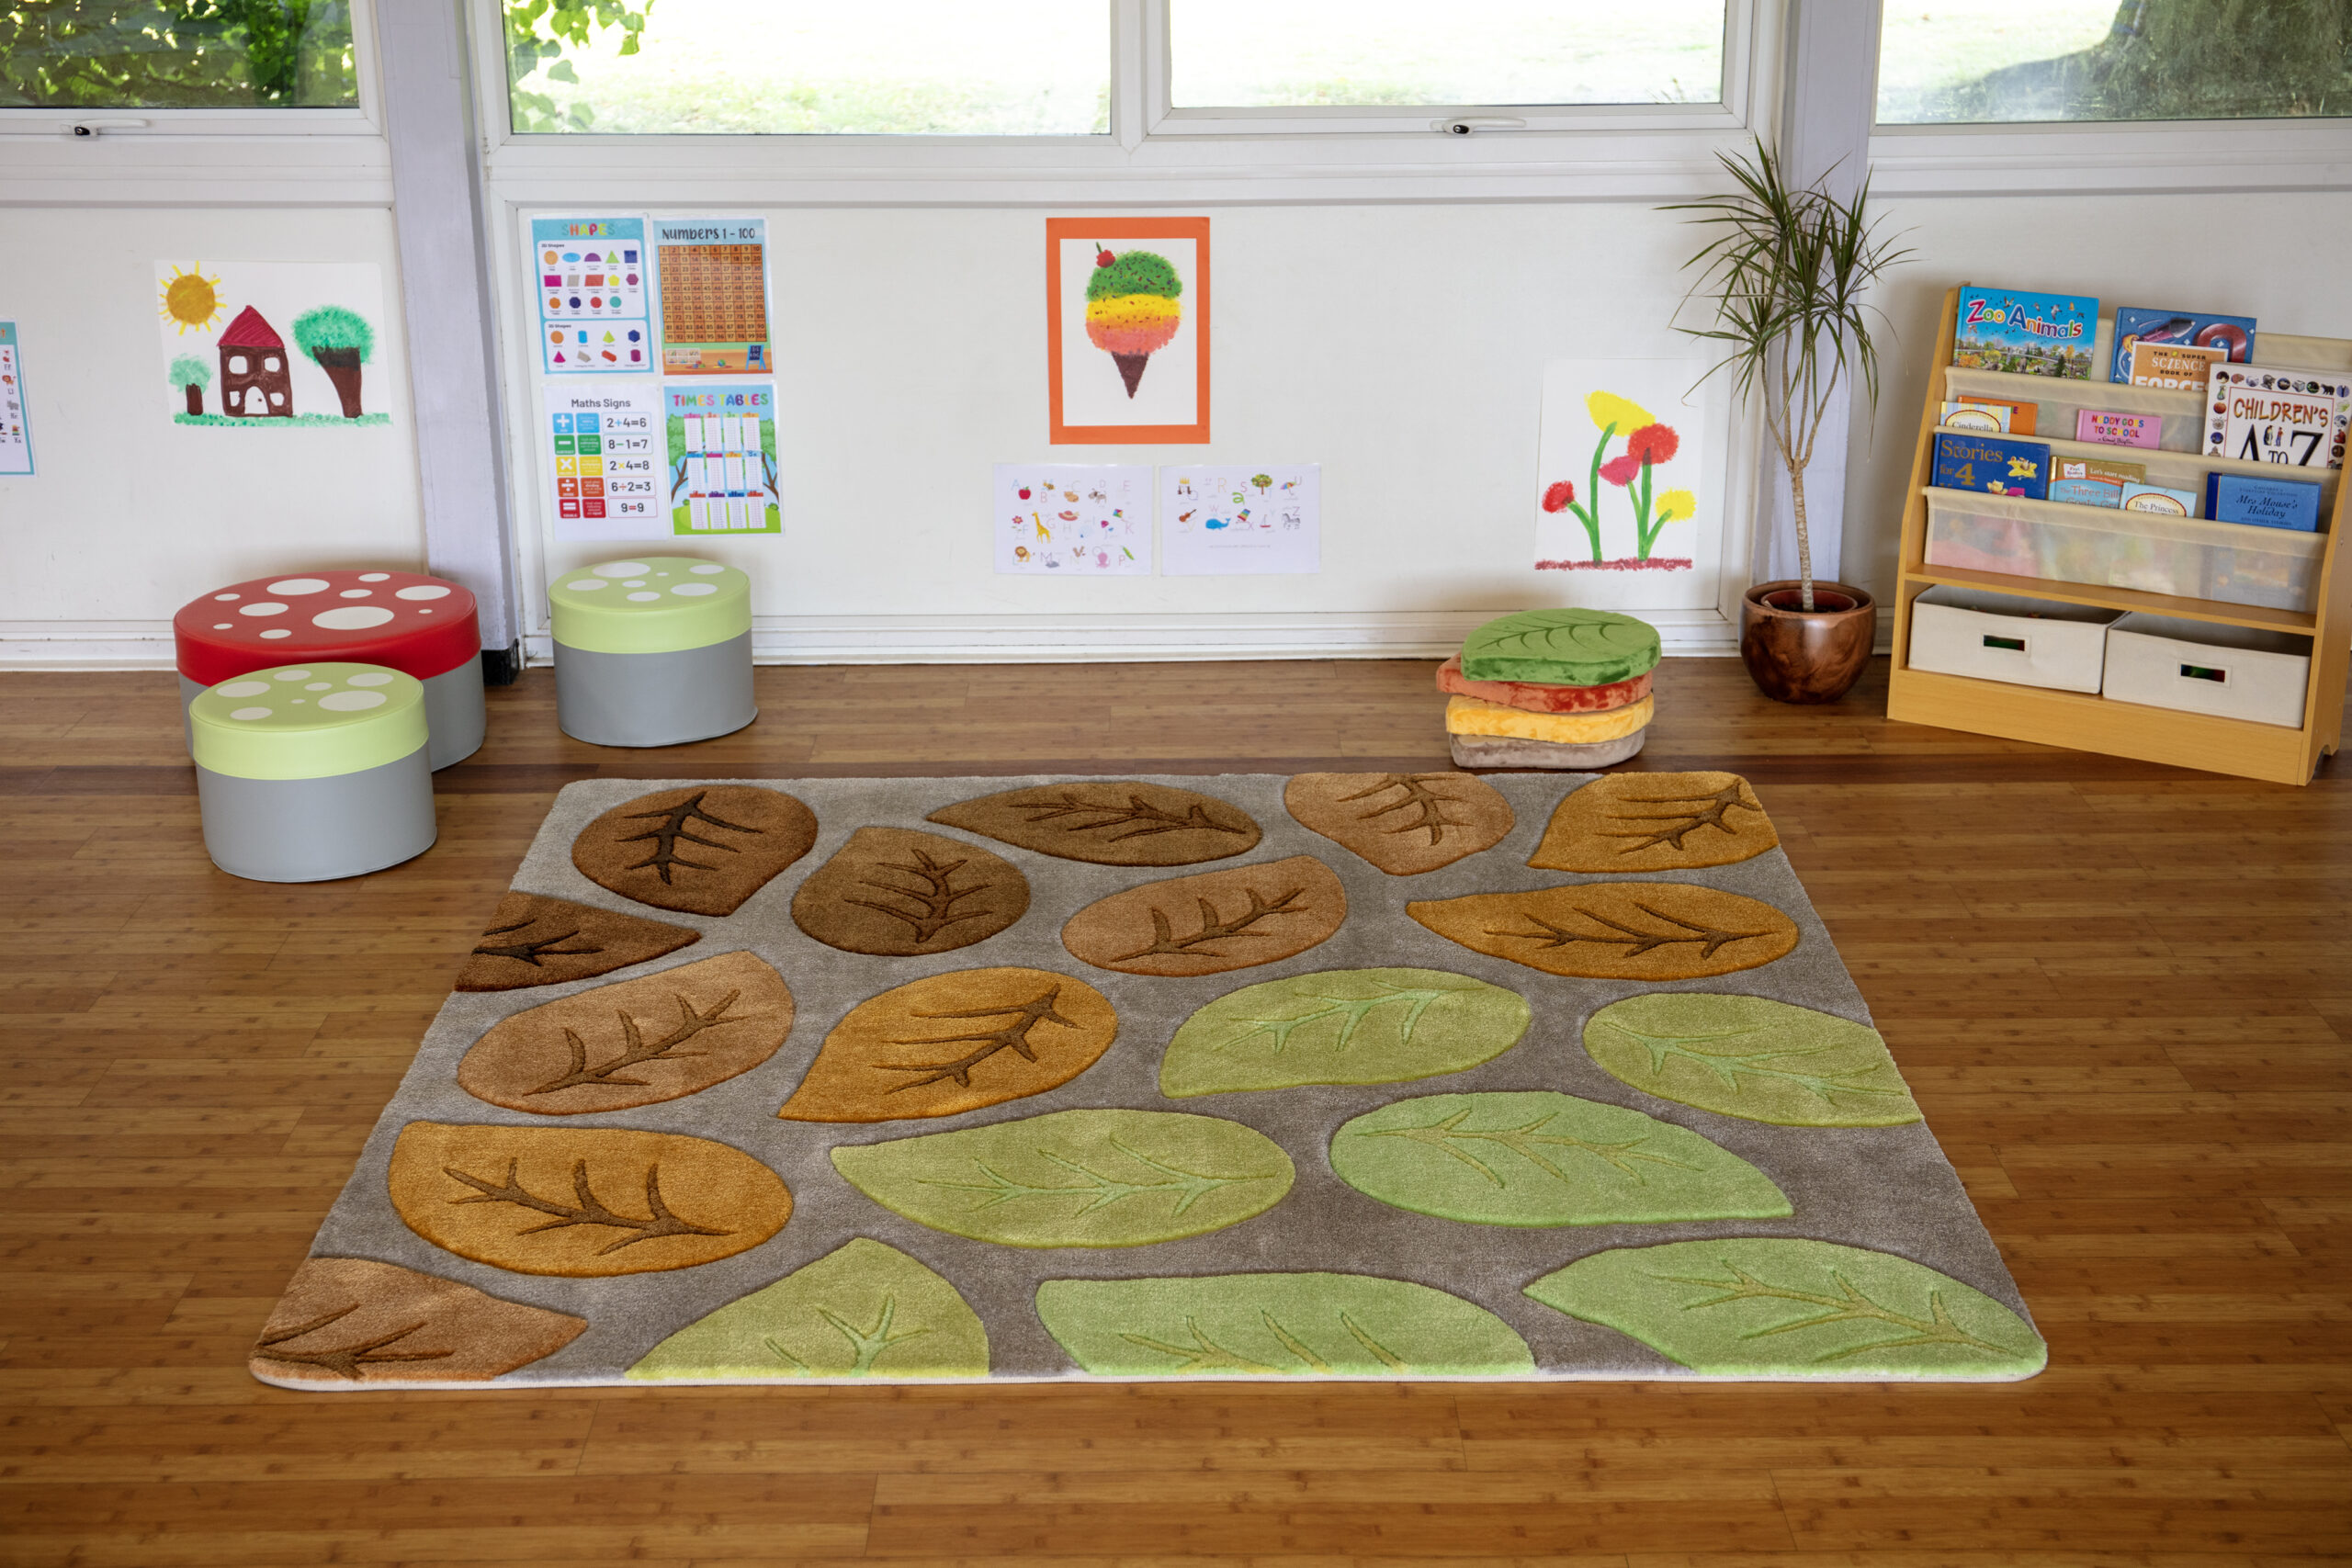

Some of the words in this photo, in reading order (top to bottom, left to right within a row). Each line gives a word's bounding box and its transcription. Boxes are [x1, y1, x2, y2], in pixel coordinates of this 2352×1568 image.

[561, 223, 615, 236] SHAPES
[662, 228, 719, 240] Numbers
[723, 228, 726, 239] 1
[739, 228, 755, 239] 100
[1967, 299, 2006, 323] Zoo
[2007, 304, 2083, 339] Animals
[2152, 357, 2205, 372] SCIENCE
[2135, 376, 2207, 391] FORCE
[571, 399, 601, 408] Maths
[603, 398, 631, 409] Signs
[673, 394, 714, 406] TIMES
[718, 393, 769, 406] TABLES
[2233, 397, 2329, 428] CHILDREN'S
[1952, 421, 1994, 432] Cinderella
[2092, 415, 2120, 425] NODDY
[2122, 418, 2144, 428] GOES
[2095, 425, 2105, 434] TO
[2107, 427, 2139, 438] SCHOOL
[1940, 440, 2004, 463] Stories
[1940, 464, 1954, 475] for
[1955, 463, 1975, 486] 4
[1124, 480, 1132, 492] E
[1218, 477, 1227, 493] R
[1240, 481, 1247, 493] S
[1040, 492, 1047, 503] B
[2071, 485, 2101, 496] Three
[2103, 488, 2119, 499] Bill
[2134, 501, 2148, 509] The
[2150, 503, 2179, 514] Princess
[2236, 495, 2257, 505] Mrs
[2259, 497, 2298, 510] Mouse's
[2247, 505, 2286, 520] Holiday
